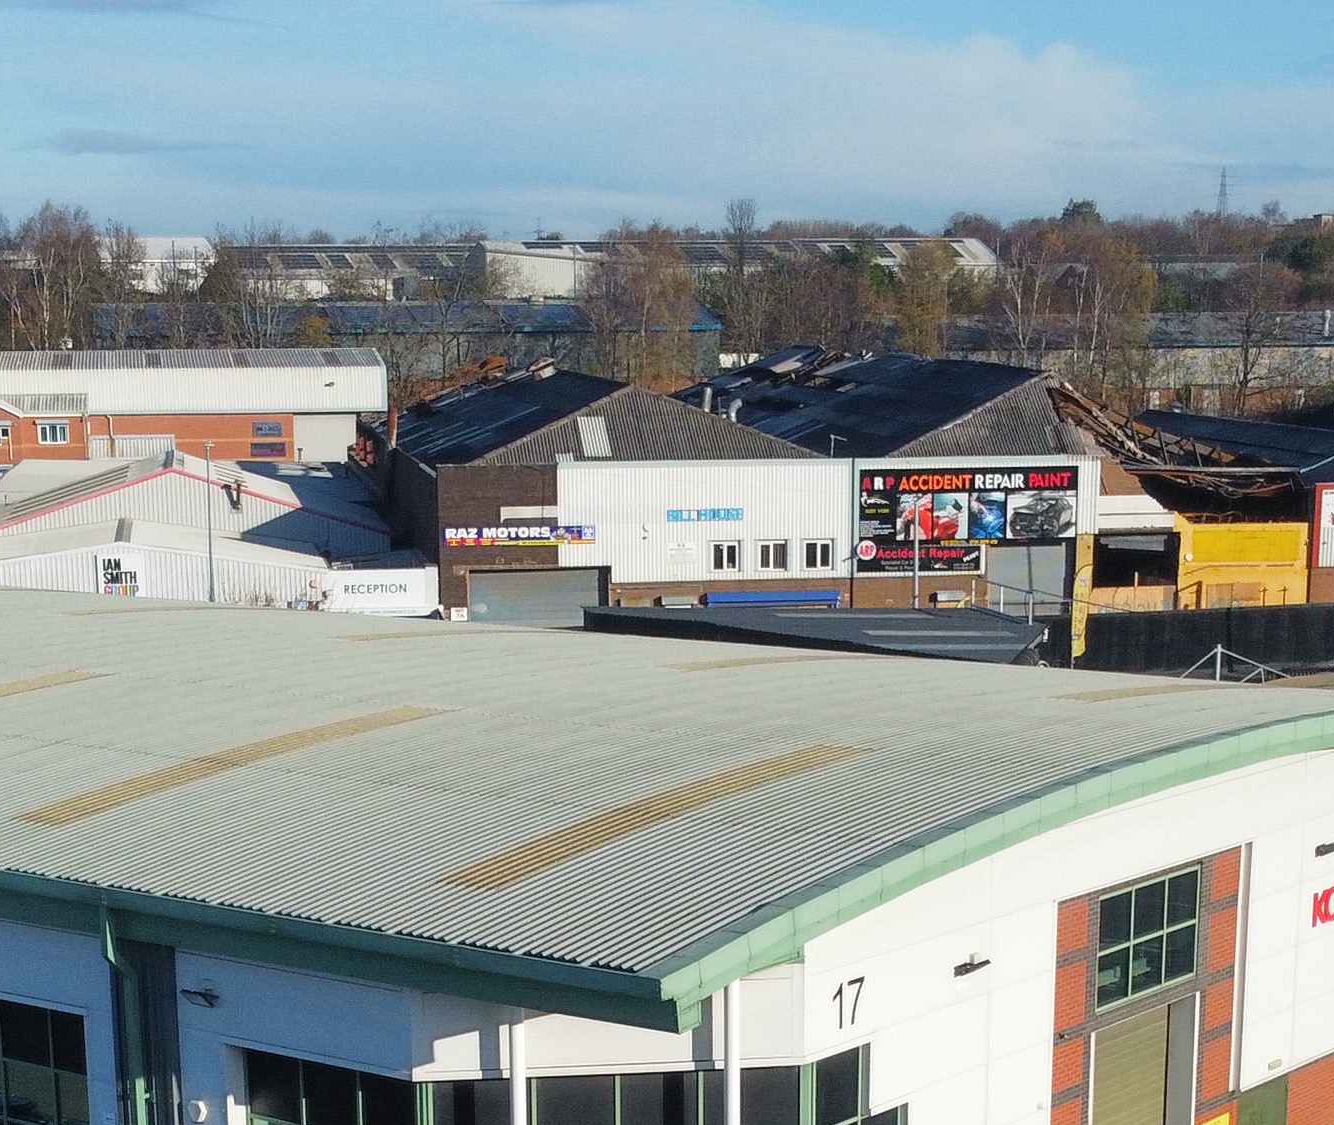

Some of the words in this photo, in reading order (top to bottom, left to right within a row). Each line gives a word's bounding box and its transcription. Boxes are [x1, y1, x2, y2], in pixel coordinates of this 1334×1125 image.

[898, 474, 972, 491] ACCIDENT
[975, 473, 1025, 489] REPAIR
[1028, 472, 1072, 487] PAINT
[445, 528, 478, 539] RAZ
[482, 527, 551, 539] MOTORS
[929, 547, 966, 560] Repair
[102, 558, 121, 571] IAN
[103, 571, 137, 584] SMITH
[343, 583, 408, 595] RECEPTION
[832, 975, 865, 1030] 17
